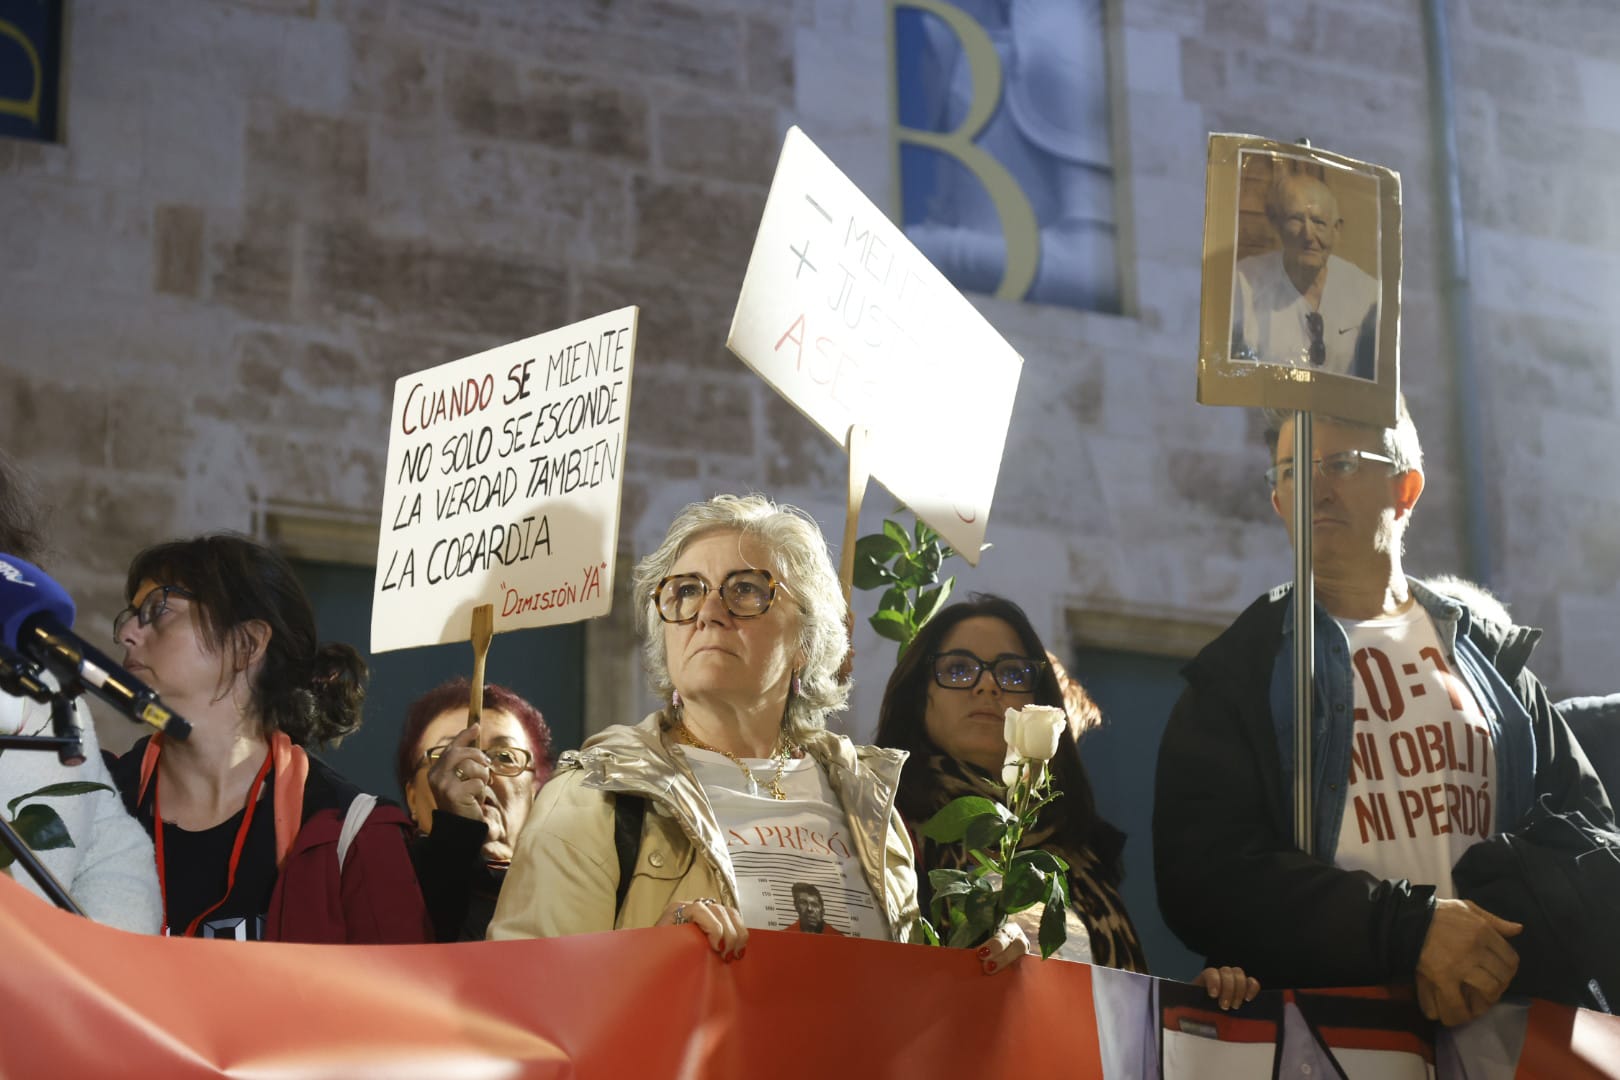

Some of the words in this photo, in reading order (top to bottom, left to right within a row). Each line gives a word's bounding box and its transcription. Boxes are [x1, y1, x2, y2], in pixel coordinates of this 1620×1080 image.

[402, 374, 494, 436] CUANDO
[503, 358, 536, 405] SE
[545, 327, 629, 391] MIENTE
[398, 442, 433, 485] NO
[441, 426, 493, 475] SOLO
[498, 411, 533, 458] SE
[530, 381, 623, 448] ESCONDE
[392, 493, 421, 531] LA
[436, 467, 518, 521] VERDAD
[525, 432, 620, 498] TAMBIEN
[381, 548, 415, 591] LA
[1353, 646, 1485, 722] 0:1
[1349, 732, 1384, 785] NI
[1389, 721, 1491, 778] OBLIT
[754, 825, 851, 859] PRESÓ
[1353, 792, 1396, 844] NI
[1398, 781, 1492, 840] PERDÓ
